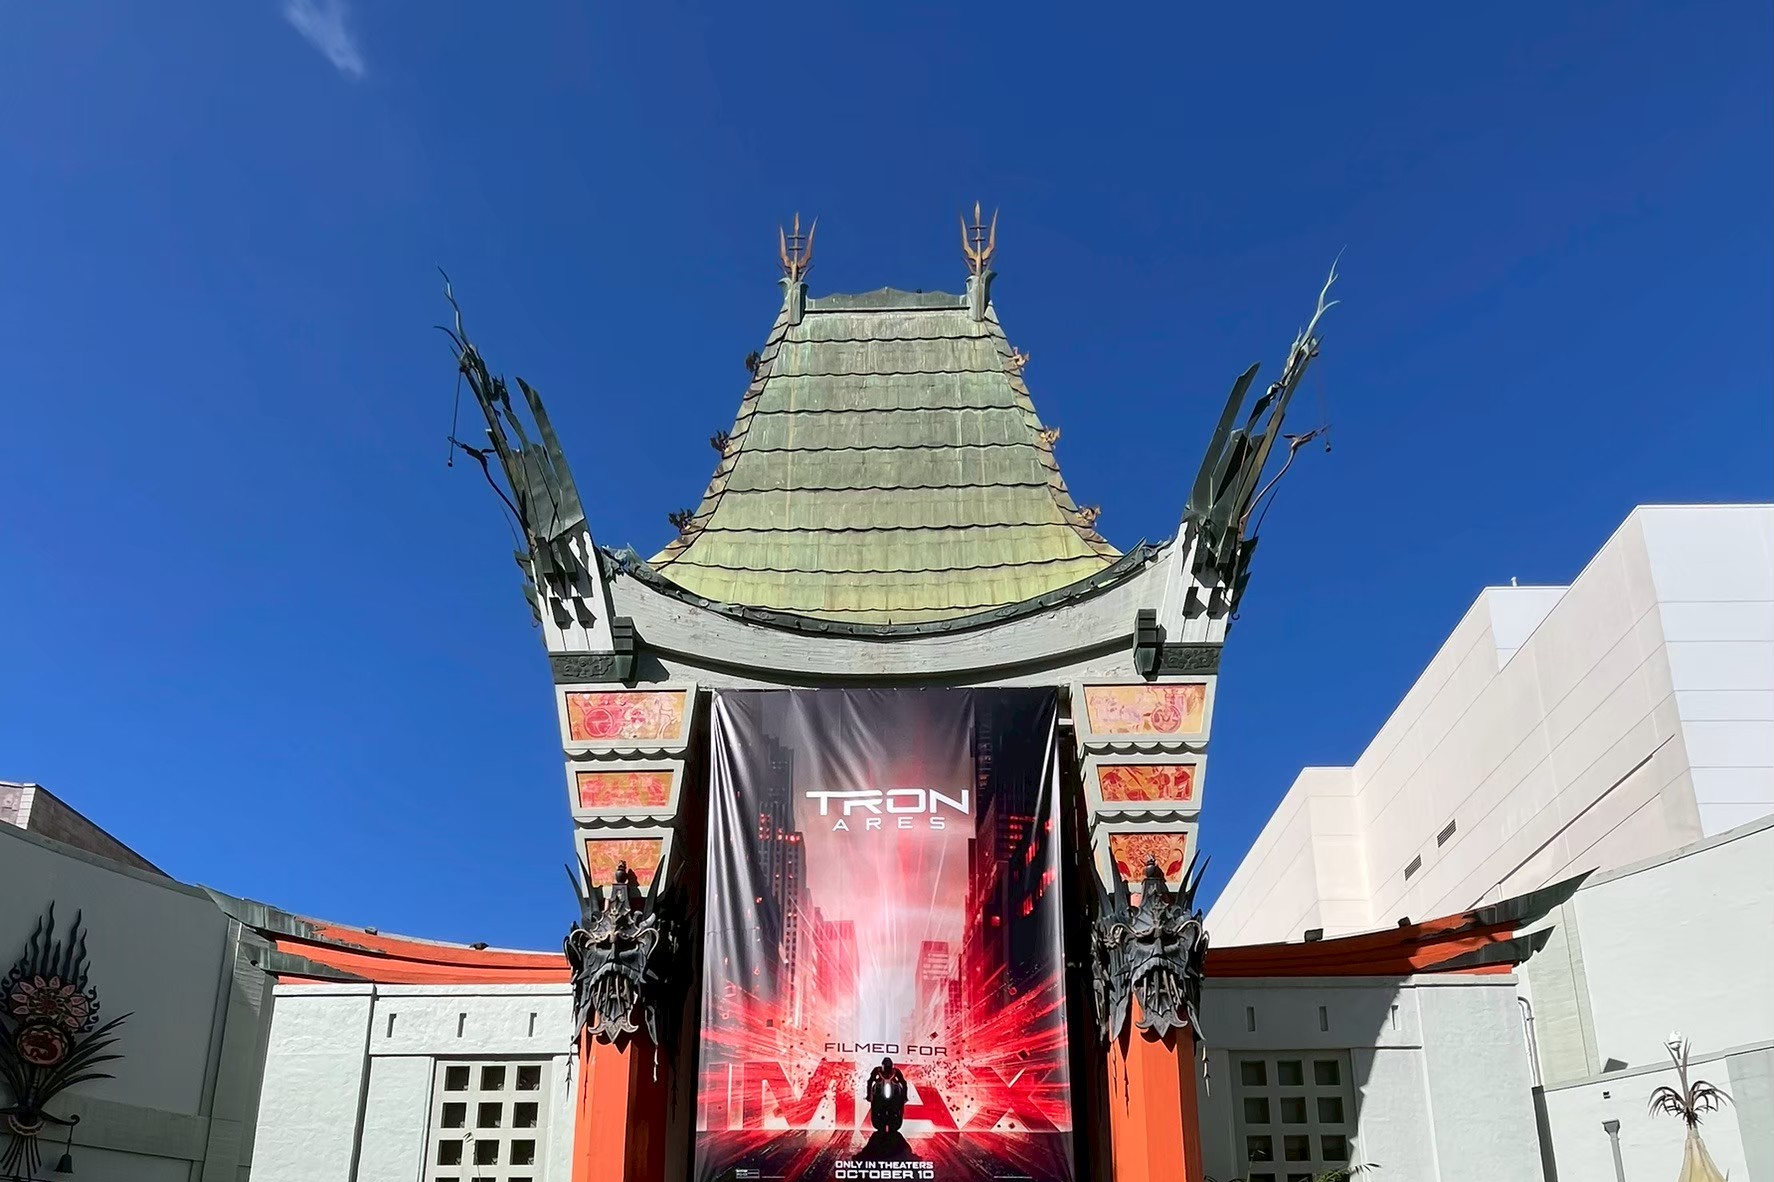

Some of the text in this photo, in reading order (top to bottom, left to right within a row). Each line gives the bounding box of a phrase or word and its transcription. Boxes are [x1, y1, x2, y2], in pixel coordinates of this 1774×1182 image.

[806, 789, 969, 815] TRON
[832, 816, 946, 831] ARES
[824, 1041, 948, 1056] FILMED FOR
[835, 1160, 934, 1169] ONLY IN THEATERS
[835, 1170, 934, 1179] OCTOBER 10
